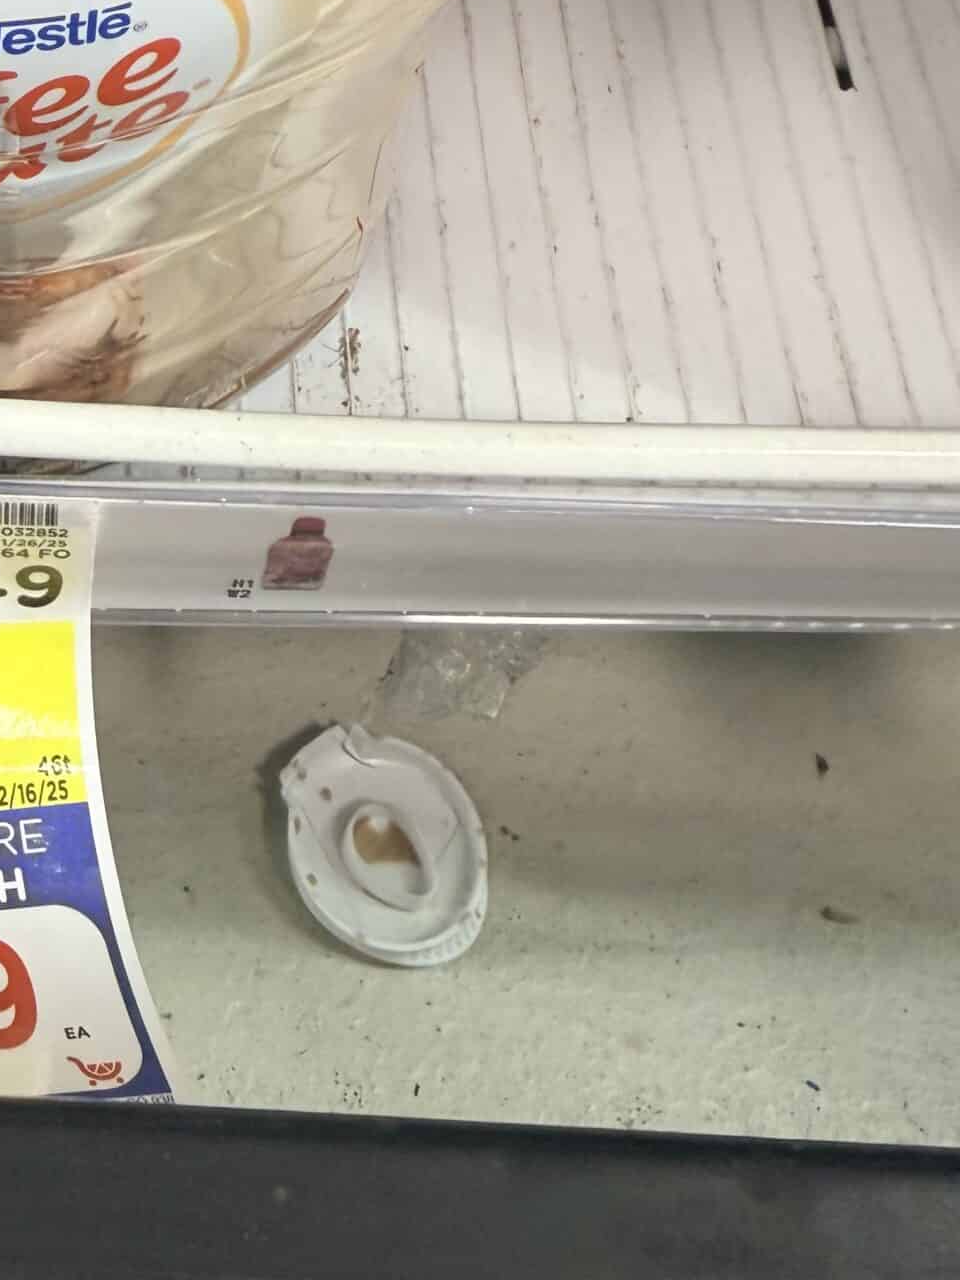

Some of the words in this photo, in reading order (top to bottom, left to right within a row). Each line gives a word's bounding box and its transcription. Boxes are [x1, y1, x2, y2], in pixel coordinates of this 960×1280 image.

[1, 548, 31, 559] 64
[38, 548, 72, 560] FO
[64, 1025, 92, 1040] EA
